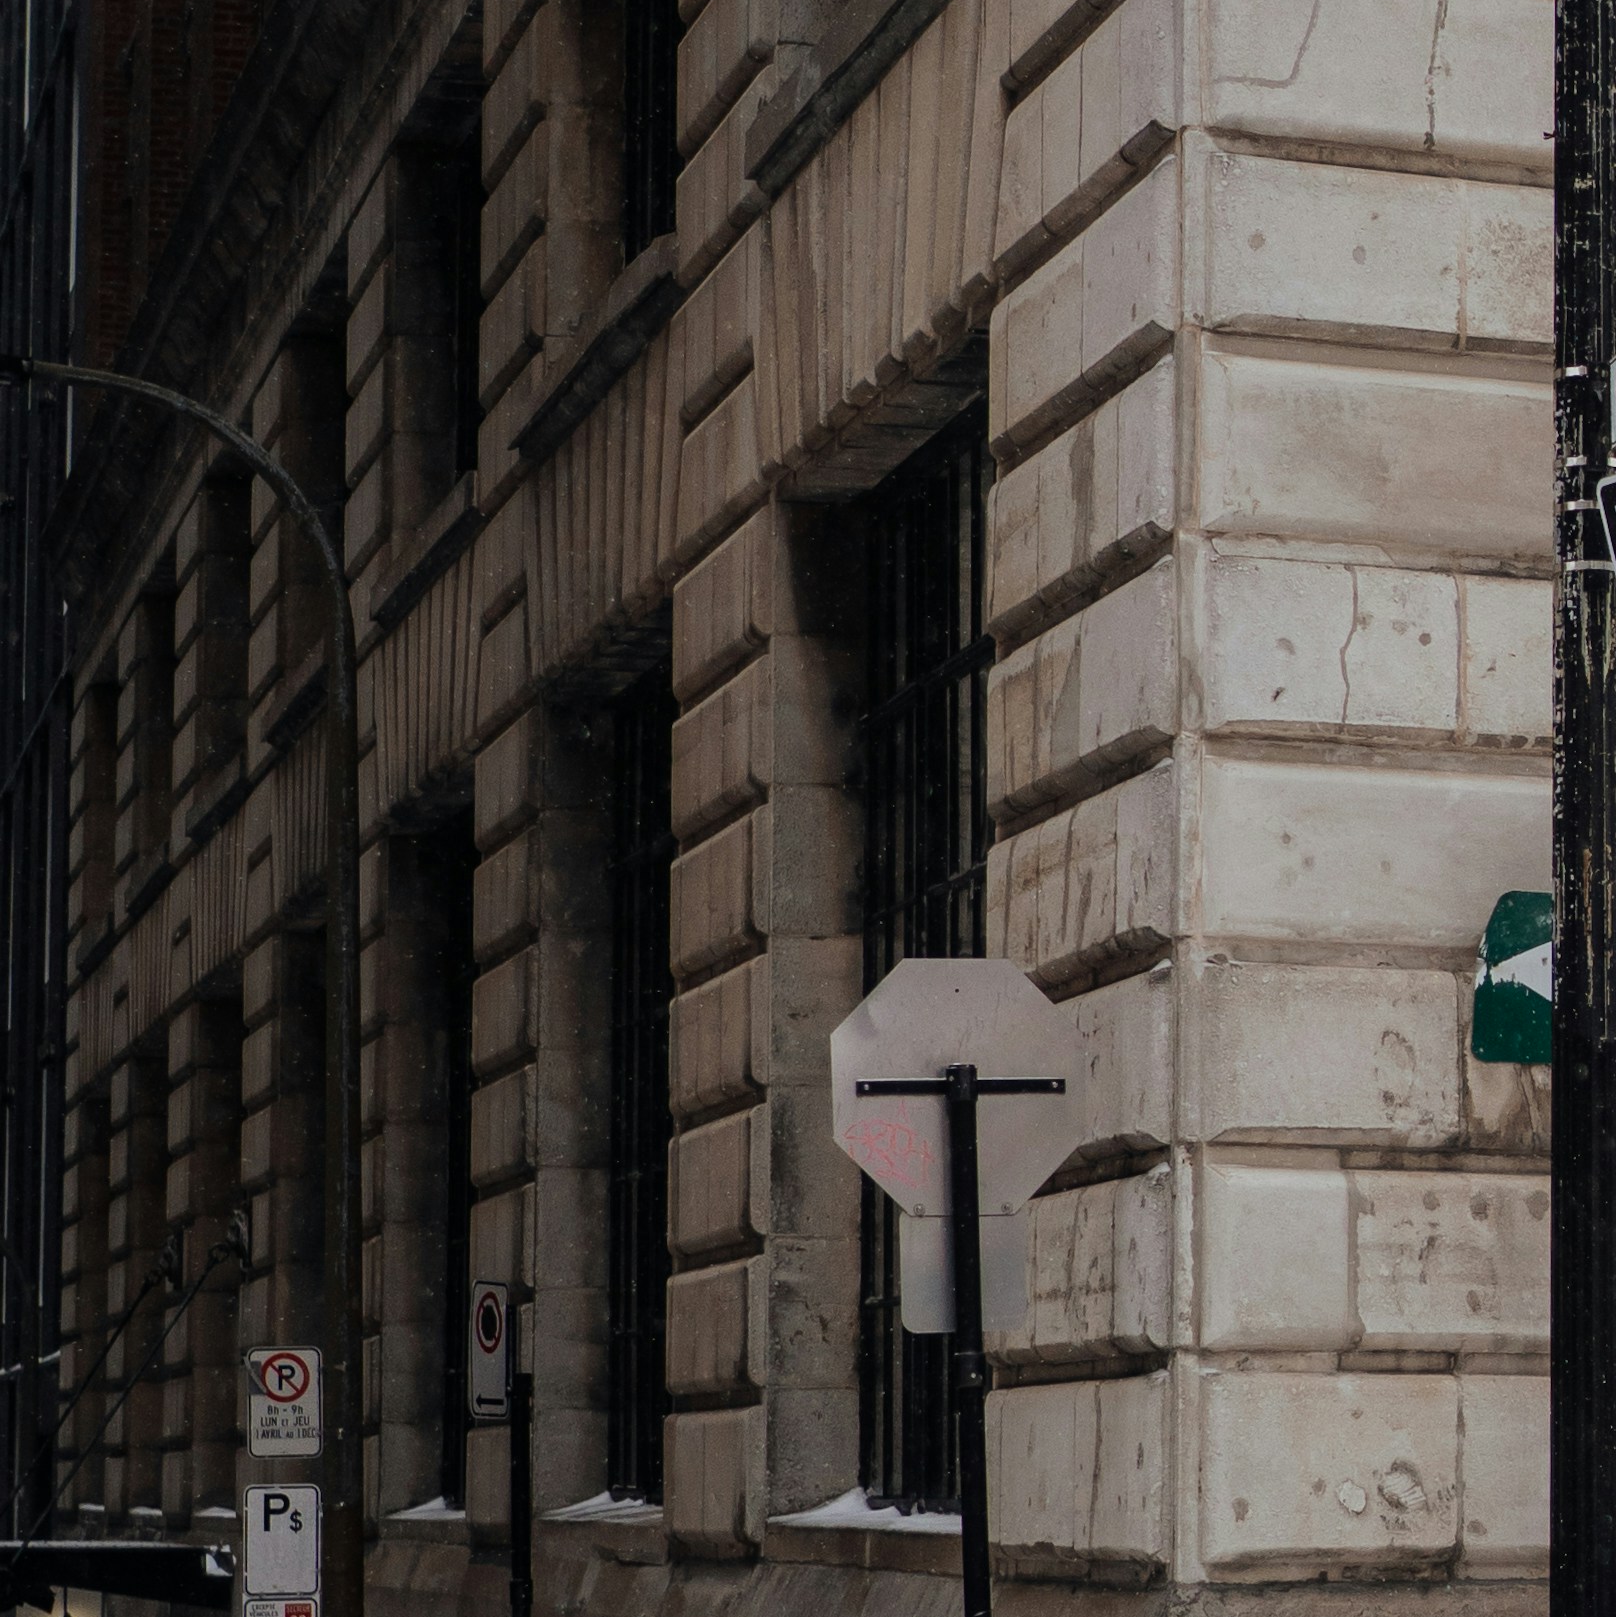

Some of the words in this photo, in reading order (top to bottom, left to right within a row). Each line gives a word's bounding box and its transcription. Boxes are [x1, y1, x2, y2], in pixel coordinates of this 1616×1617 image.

[267, 1405, 280, 1415] 8h
[291, 1405, 304, 1415] 9h
[260, 1417, 278, 1426] LUN
[293, 1416, 310, 1426] JEU
[261, 1430, 282, 1439] AVRIL
